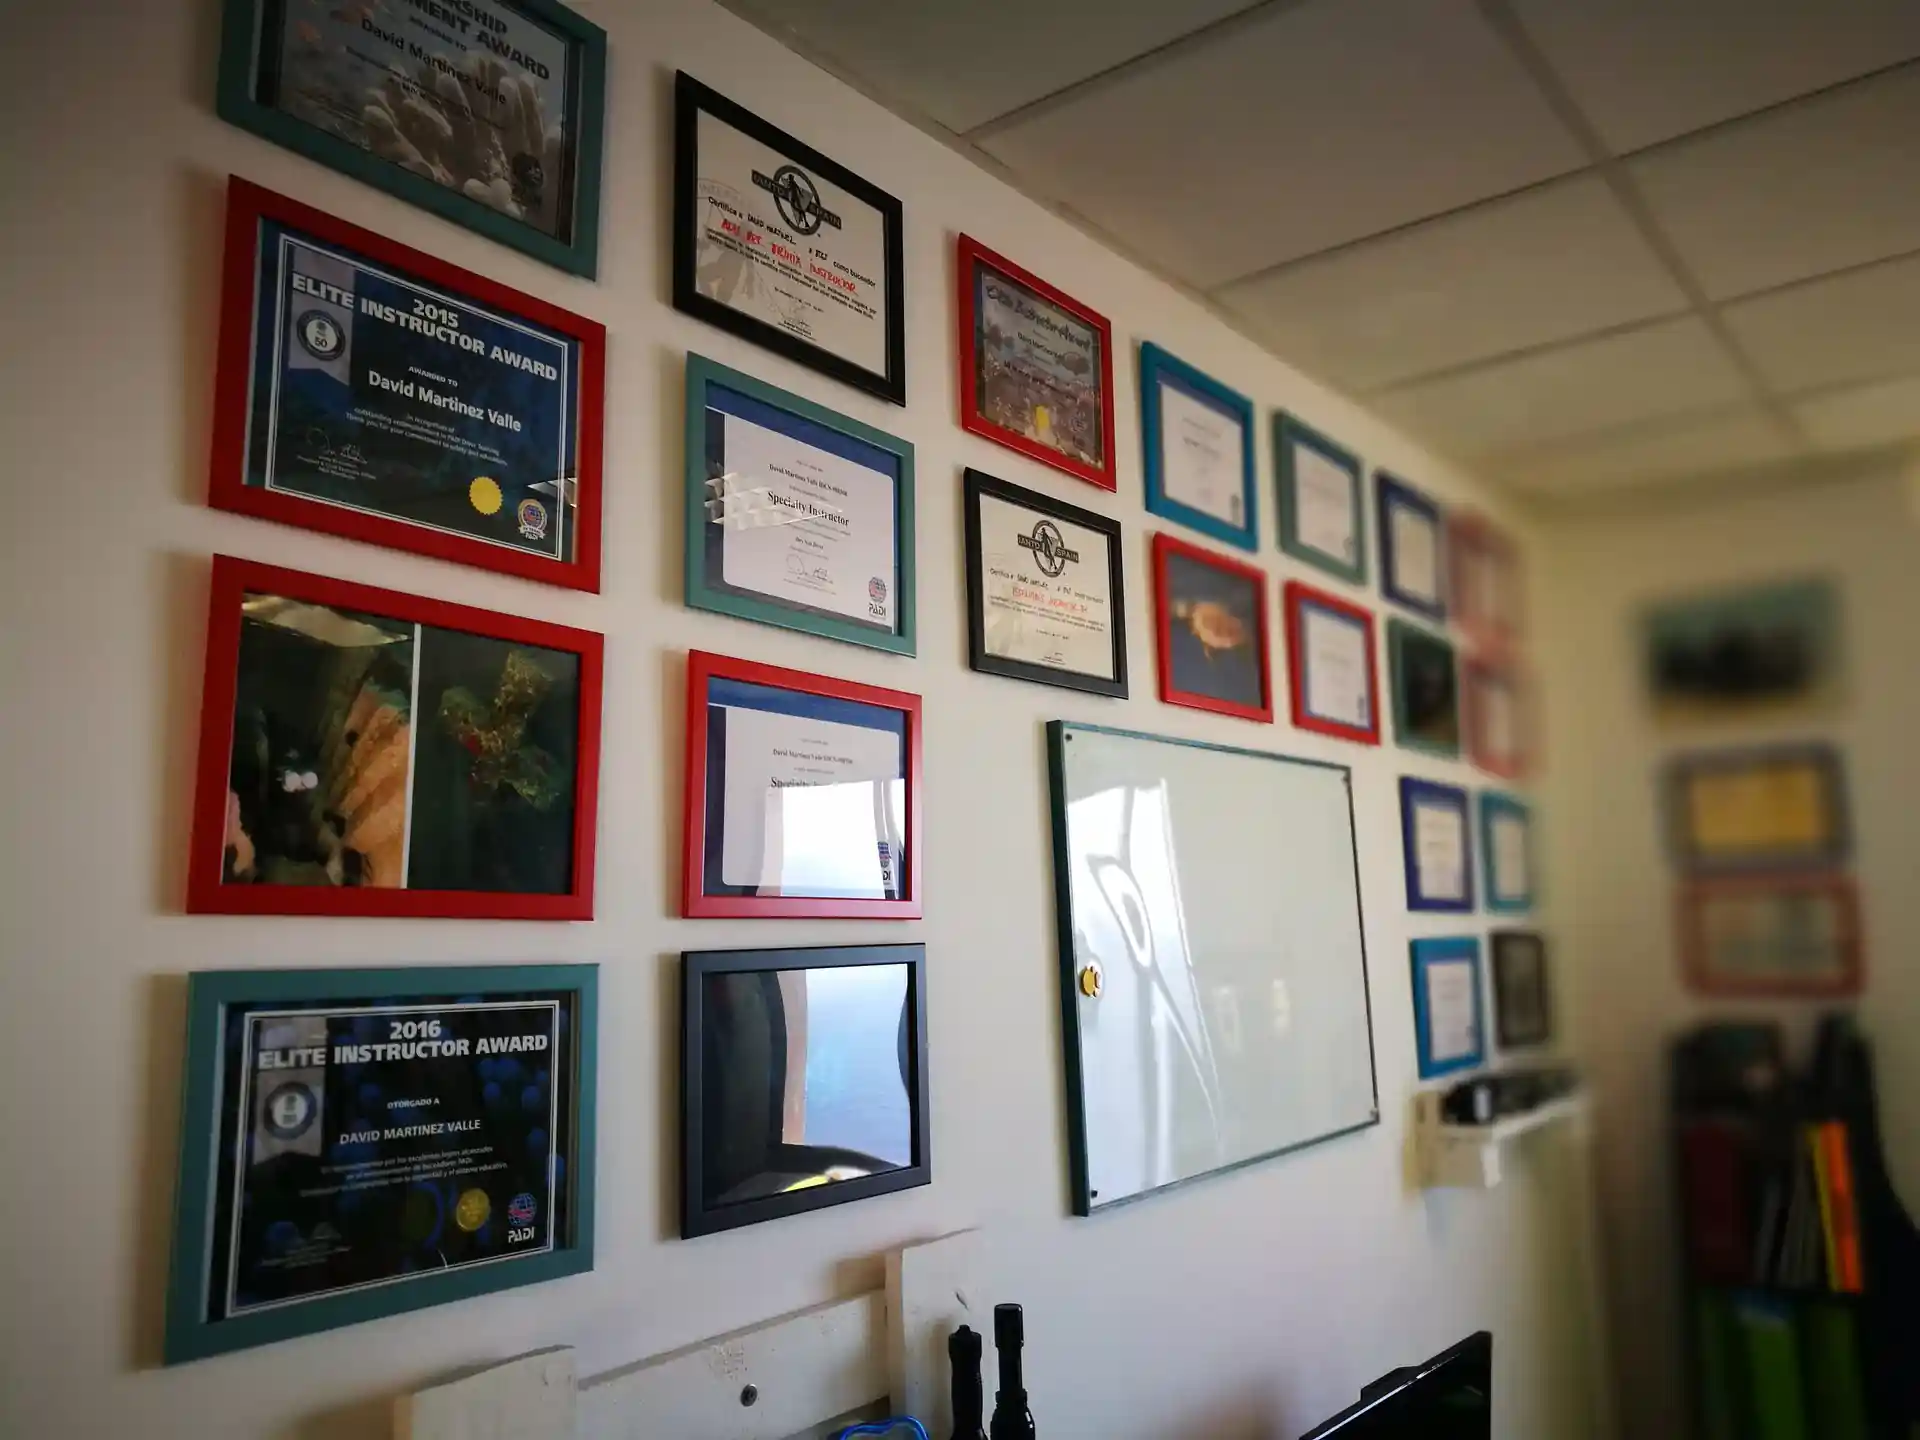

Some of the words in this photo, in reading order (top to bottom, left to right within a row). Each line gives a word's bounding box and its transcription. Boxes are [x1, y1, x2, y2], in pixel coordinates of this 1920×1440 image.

[361, 18, 405, 51] David
[409, 42, 470, 86] Martinez
[475, 78, 507, 105] Valle
[476, 29, 550, 80] AWARD
[833, 259, 849, 274] como
[292, 272, 356, 310] ELITE
[361, 297, 485, 356] INSTRUCTOR
[490, 345, 558, 381] AWARD
[413, 299, 459, 329] 2015
[408, 366, 446, 383] AWARDED
[447, 378, 458, 387] TO
[368, 370, 414, 398] David
[418, 386, 485, 420] Martinez
[487, 408, 522, 432] Valle
[769, 463, 784, 474] David
[768, 491, 806, 513] Specialty
[809, 503, 849, 526] Instructor
[1018, 536, 1040, 550] IANTD
[1056, 547, 1078, 561] SPAIN
[868, 602, 886, 616] PADI
[773, 747, 787, 756] David
[390, 1020, 442, 1041] 2016
[258, 1046, 327, 1070] ELITE
[334, 1038, 470, 1065] INSTRUCTOR
[475, 1034, 548, 1056] AWARD
[386, 1098, 432, 1111] OTORGADO
[432, 1097, 440, 1106] A
[339, 1129, 381, 1146] DAVID
[384, 1123, 445, 1142] MARTINEZ
[446, 1119, 482, 1136] VALLE
[508, 1226, 536, 1245] PADI
